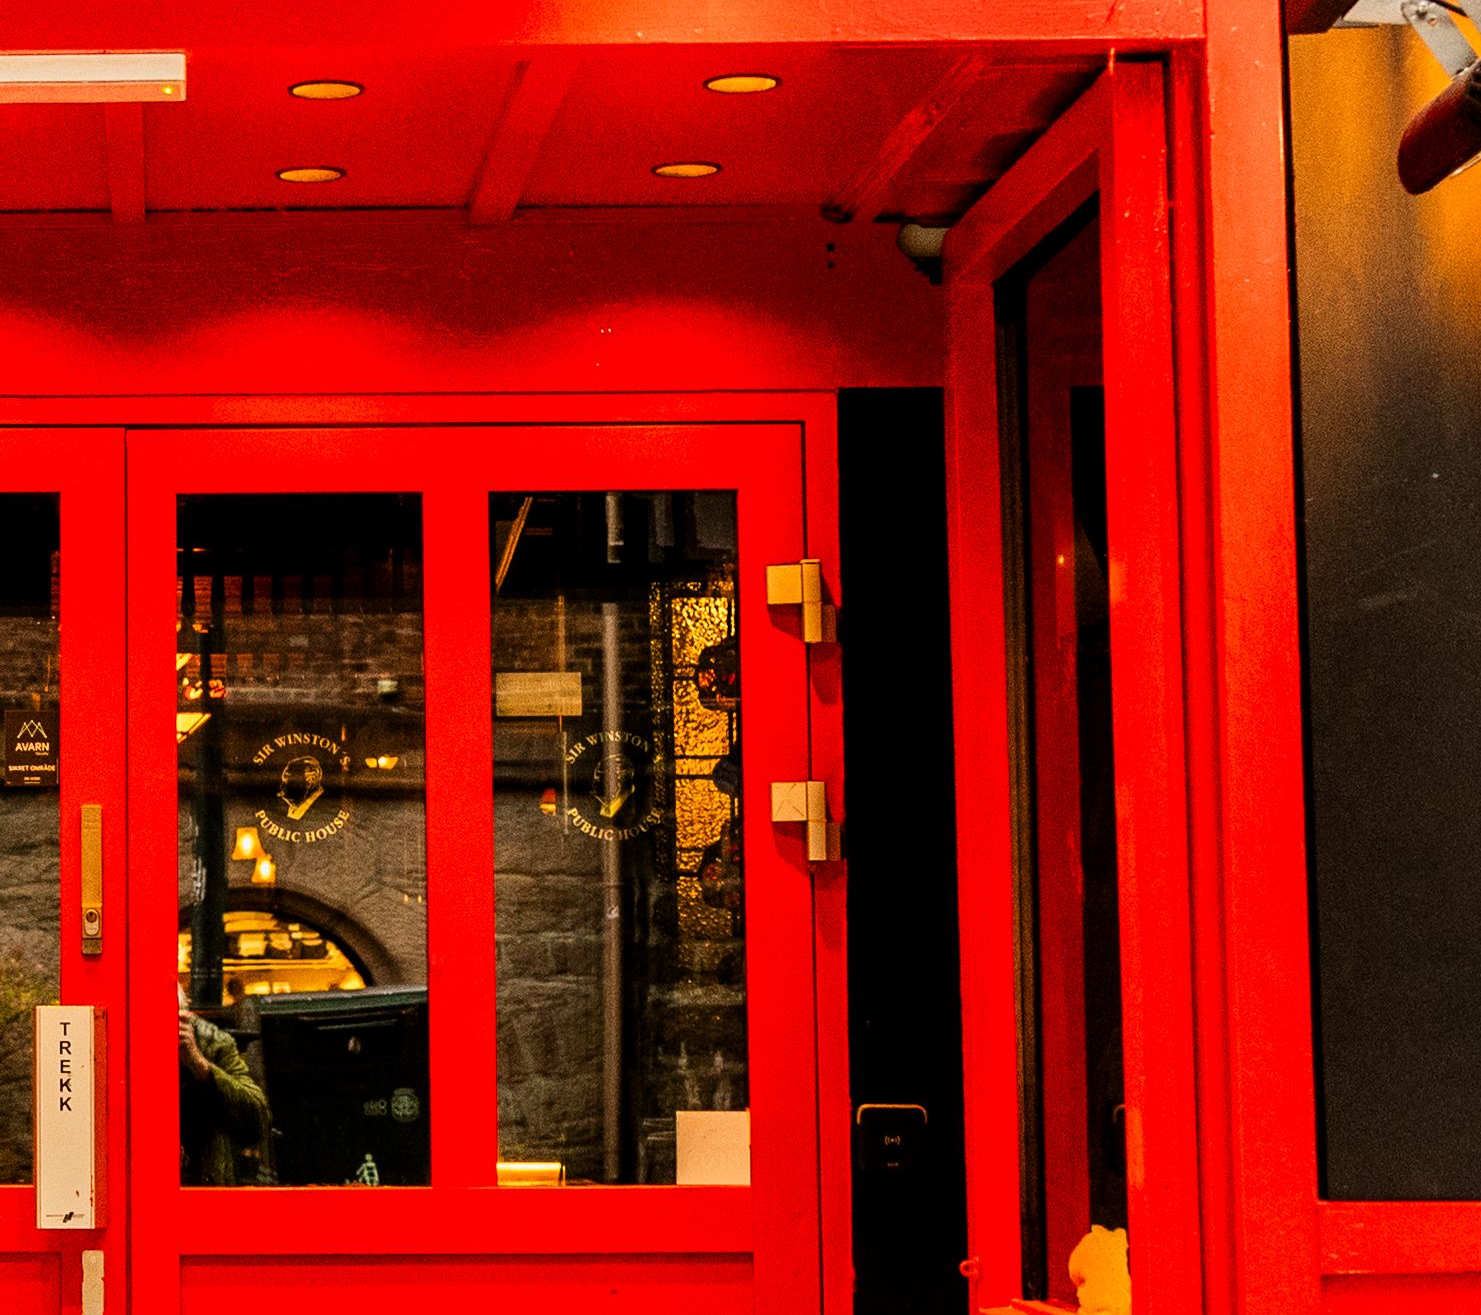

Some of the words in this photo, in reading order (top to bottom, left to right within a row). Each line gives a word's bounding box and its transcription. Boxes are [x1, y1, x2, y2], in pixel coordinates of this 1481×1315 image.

[15, 742, 50, 752] AVARN
[253, 744, 275, 765] SIR
[565, 742, 586, 764] SIR
[255, 809, 301, 843] PUBLIC
[305, 810, 350, 843] HOUSE
[566, 807, 614, 841] PUBLIC
[59, 1021, 72, 1111] TREKK
